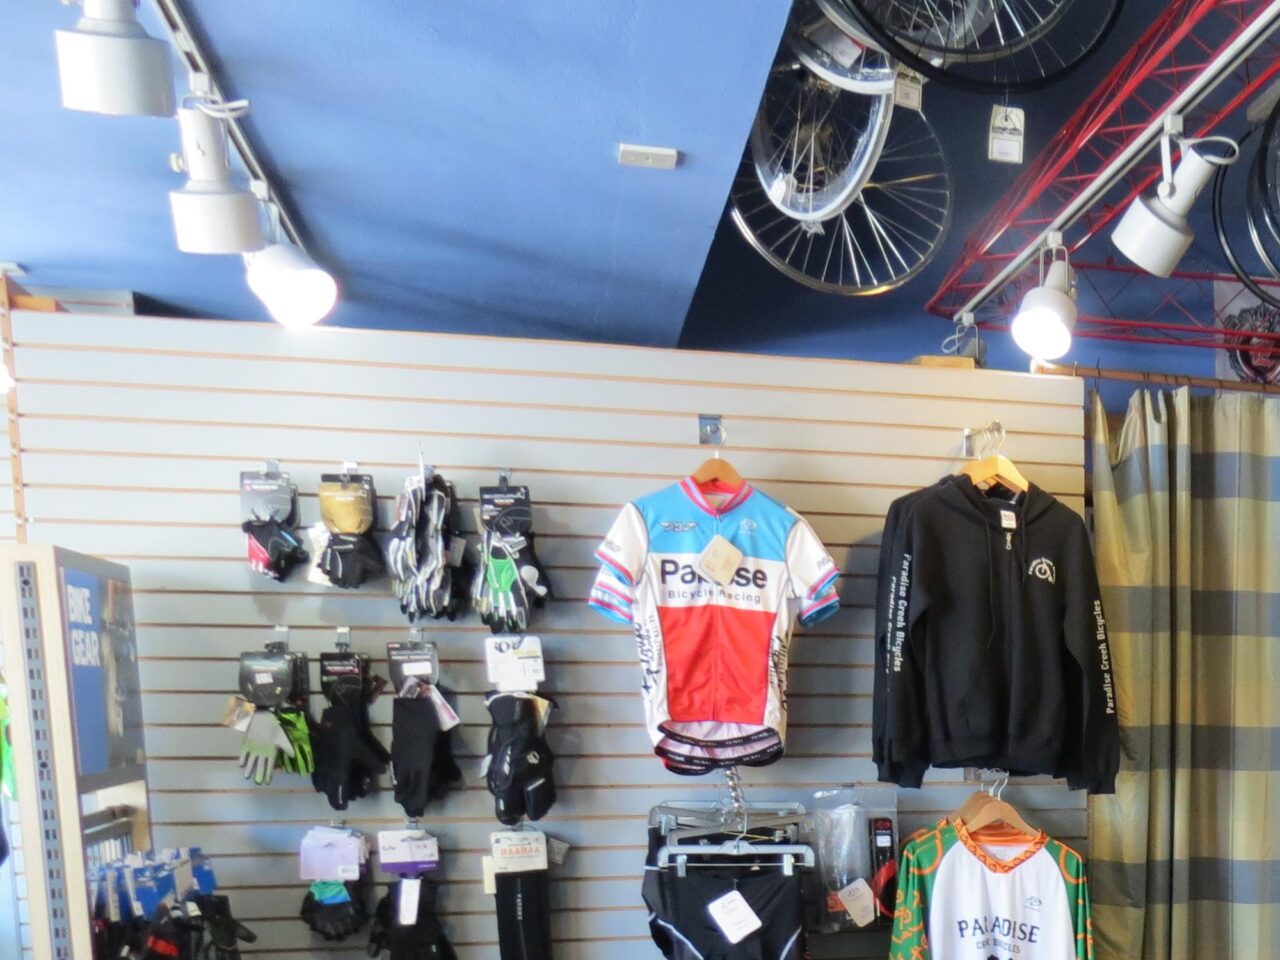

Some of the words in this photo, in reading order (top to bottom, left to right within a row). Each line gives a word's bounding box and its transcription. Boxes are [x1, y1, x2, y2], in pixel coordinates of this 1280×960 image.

[899, 553, 912, 597] Paradise
[67, 584, 93, 625] BIKE
[719, 588, 761, 605] Racing
[1094, 600, 1106, 640] Bicycles
[71, 629, 101, 667] GEAR
[893, 631, 906, 672] Bicycles
[1103, 673, 1115, 714] Paradise
